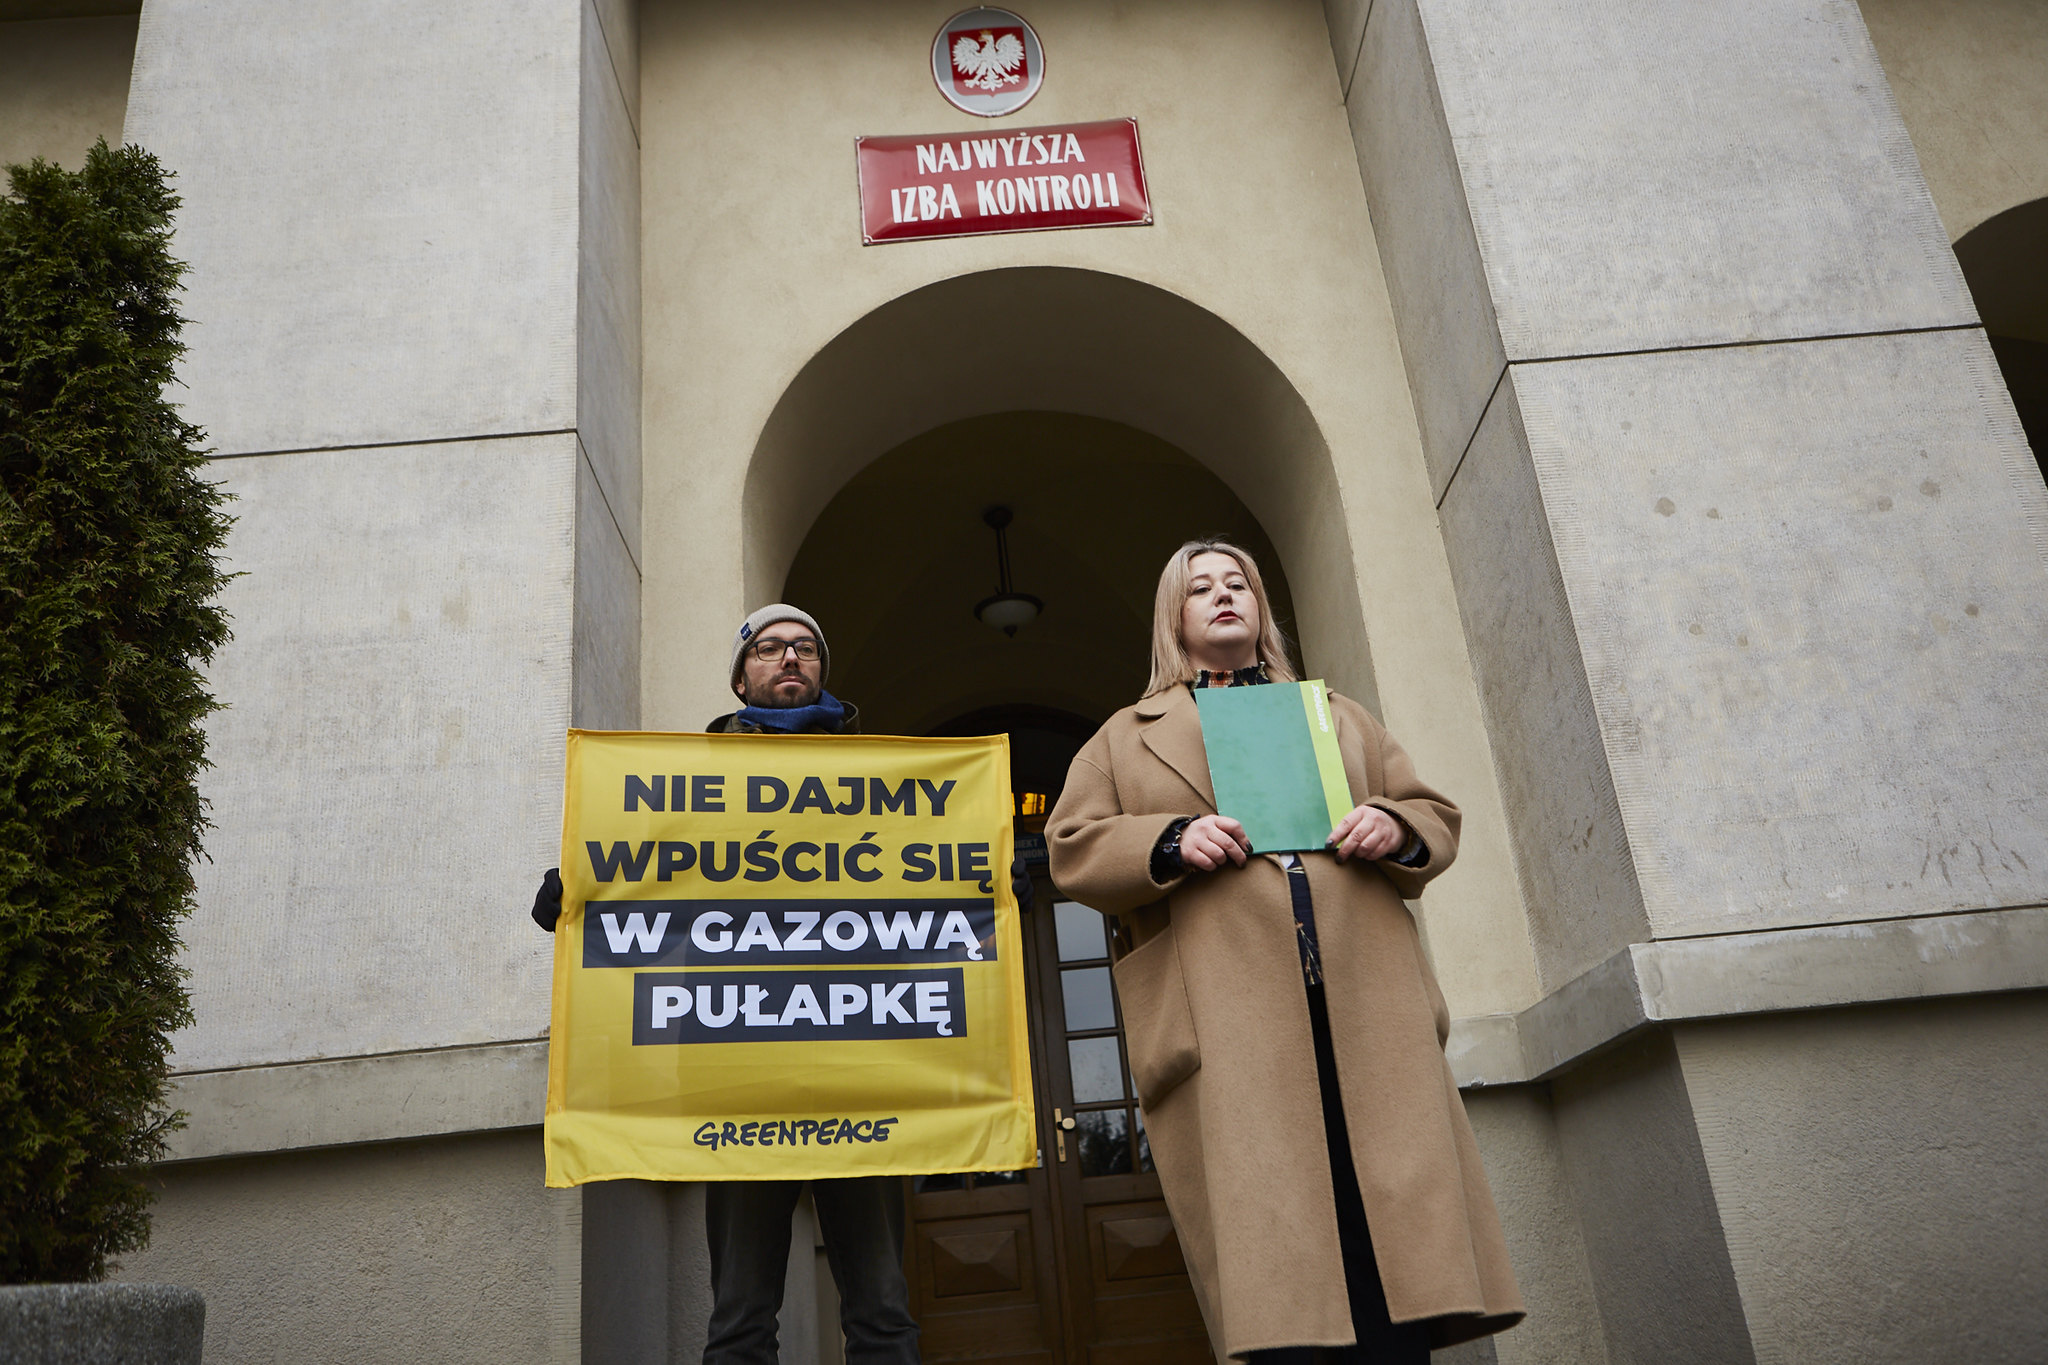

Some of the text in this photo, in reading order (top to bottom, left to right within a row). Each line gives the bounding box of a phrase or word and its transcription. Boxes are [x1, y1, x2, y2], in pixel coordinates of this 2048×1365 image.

[916, 131, 1085, 175] NAJWYŻSZA
[890, 172, 1120, 224] IZBA KONTROLI
[623, 774, 957, 817] NIE DAJMY
[585, 829, 995, 895] WPUŚCIĆ SIĘ
[600, 910, 984, 961] W GAZOWĄ
[651, 980, 953, 1036] PUŁAPKĘ
[693, 1116, 899, 1152] GREENPEACE
